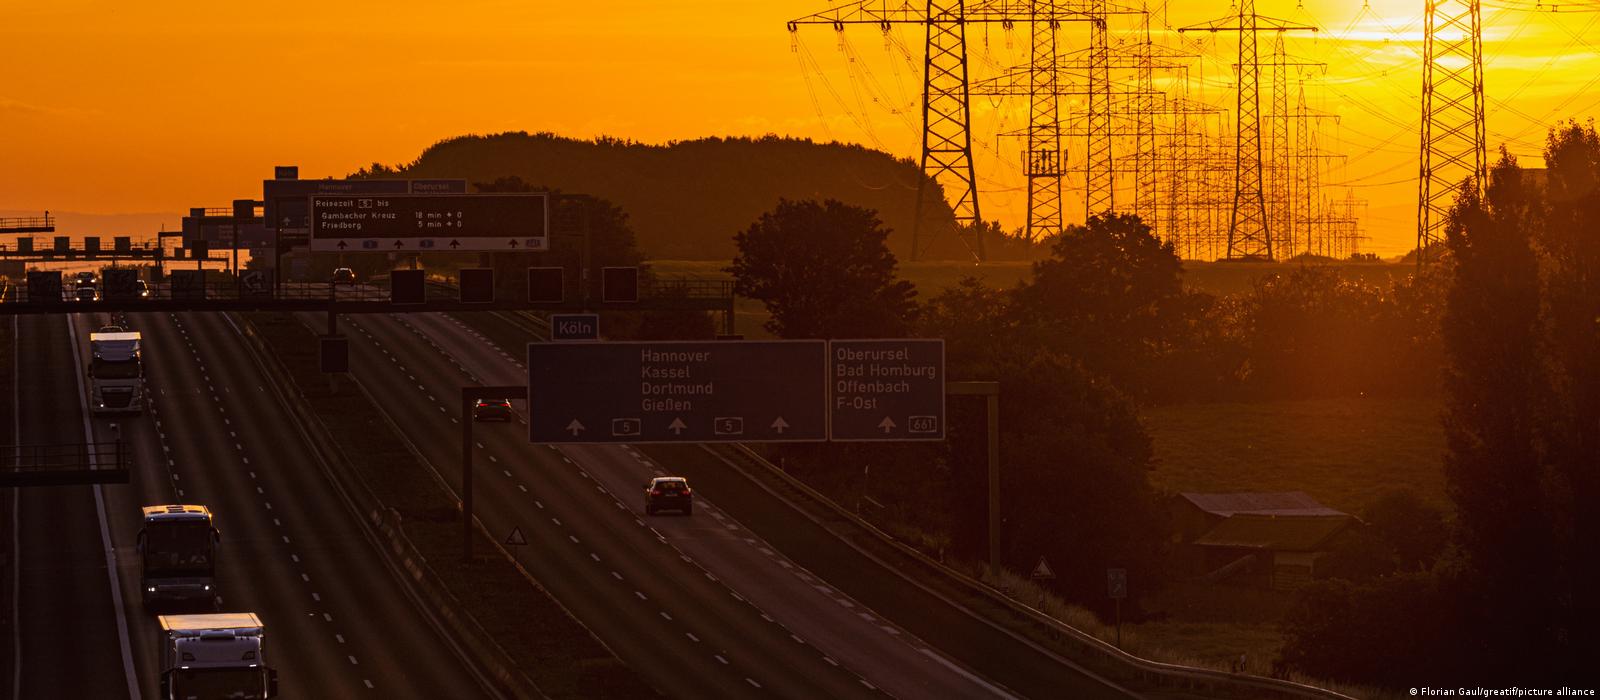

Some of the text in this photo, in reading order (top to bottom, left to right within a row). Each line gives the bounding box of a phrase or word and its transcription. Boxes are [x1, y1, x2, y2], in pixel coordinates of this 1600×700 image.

[315, 199, 354, 208] Reisezeit
[377, 199, 389, 208] bis
[321, 211, 367, 220] Gambacher
[371, 211, 397, 220] Kreuz
[427, 211, 442, 219] min
[321, 221, 362, 231] Friedberg
[418, 220, 423, 228] 5
[427, 220, 442, 228] min
[559, 320, 592, 335] Köln
[641, 348, 711, 362] Hannover
[837, 346, 909, 361] Oberursel
[641, 365, 691, 378] Kassel
[837, 363, 936, 380] Bad Homburg
[641, 381, 713, 395] Dortmund
[837, 379, 910, 393] Offenbach
[641, 398, 692, 411] Gießen
[837, 396, 877, 409] F-Ost
[623, 421, 630, 432] 5
[725, 420, 733, 432] 5
[913, 419, 932, 430] 661
